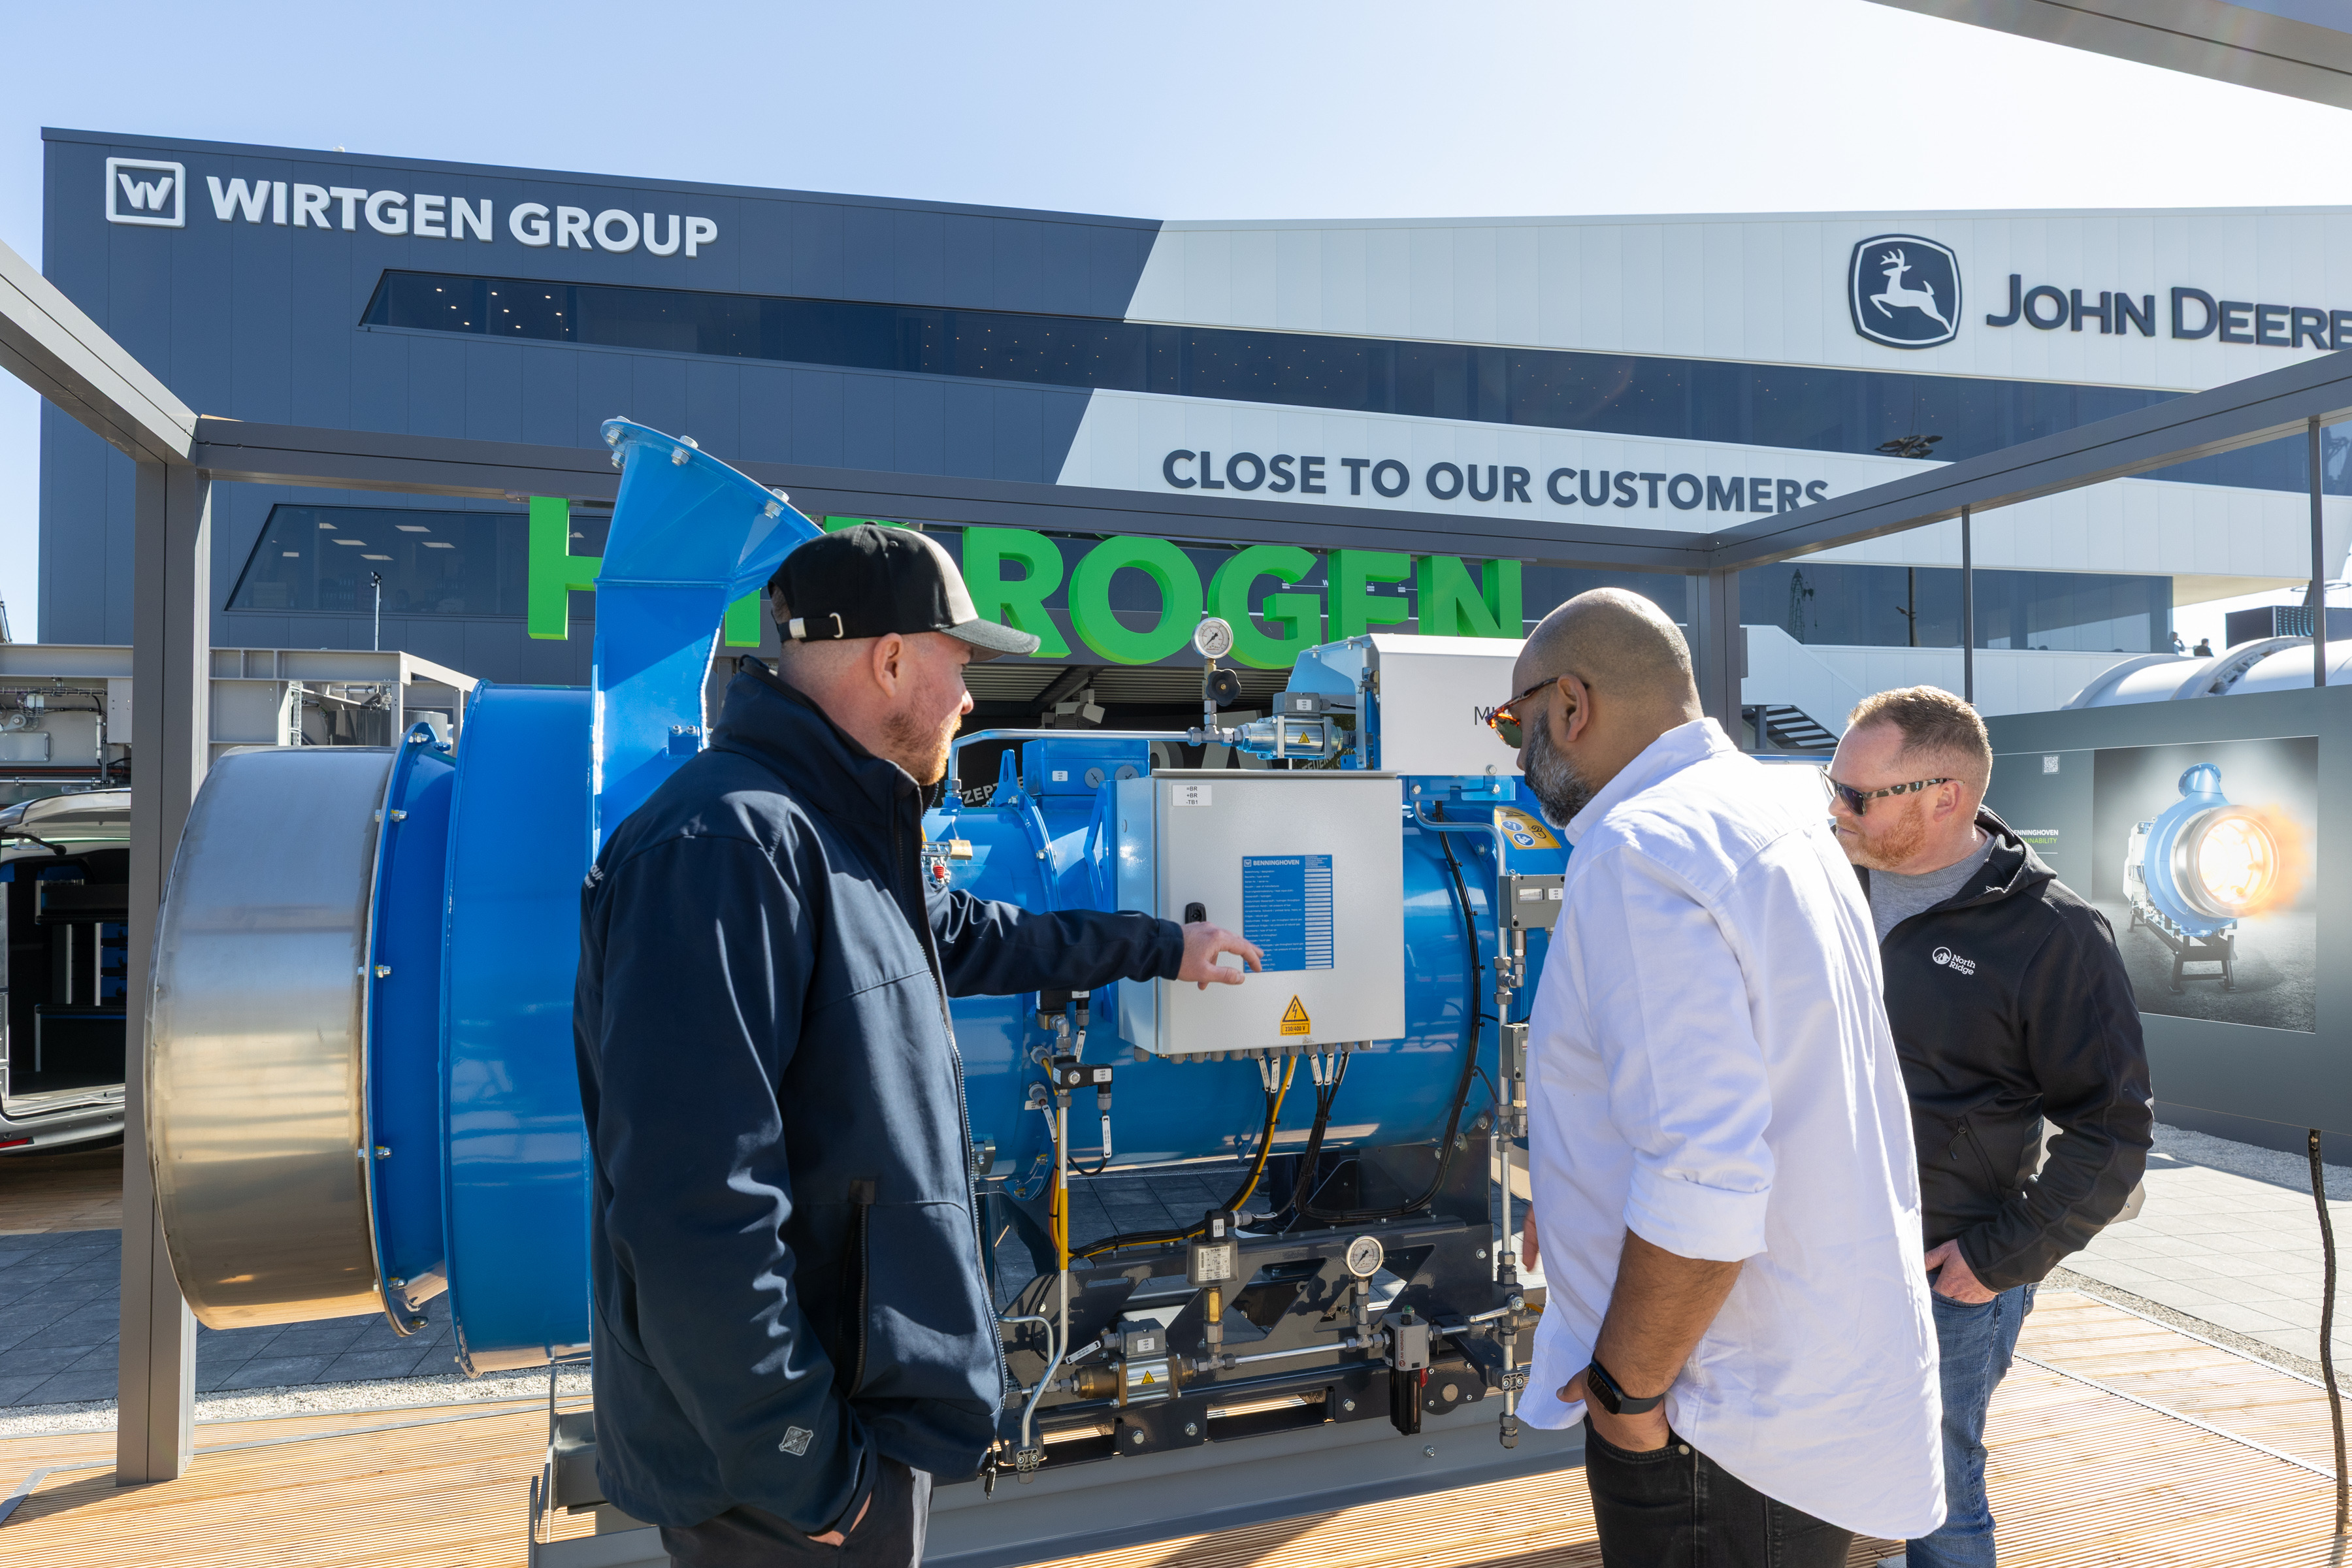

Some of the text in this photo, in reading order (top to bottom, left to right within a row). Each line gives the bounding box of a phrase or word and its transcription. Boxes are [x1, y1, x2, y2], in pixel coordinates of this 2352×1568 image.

[206, 176, 493, 242] WIRTGEN
[508, 202, 718, 258] GROUP
[1986, 273, 2352, 351] JOHN DEERE
[1162, 449, 1829, 514] CLOSE TO OUR CUSTOMERS
[528, 496, 1523, 670] HROGEN
[590, 864, 604, 881] OUP
[1949, 960, 1974, 975] Ridge
[1952, 954, 1976, 969] North
